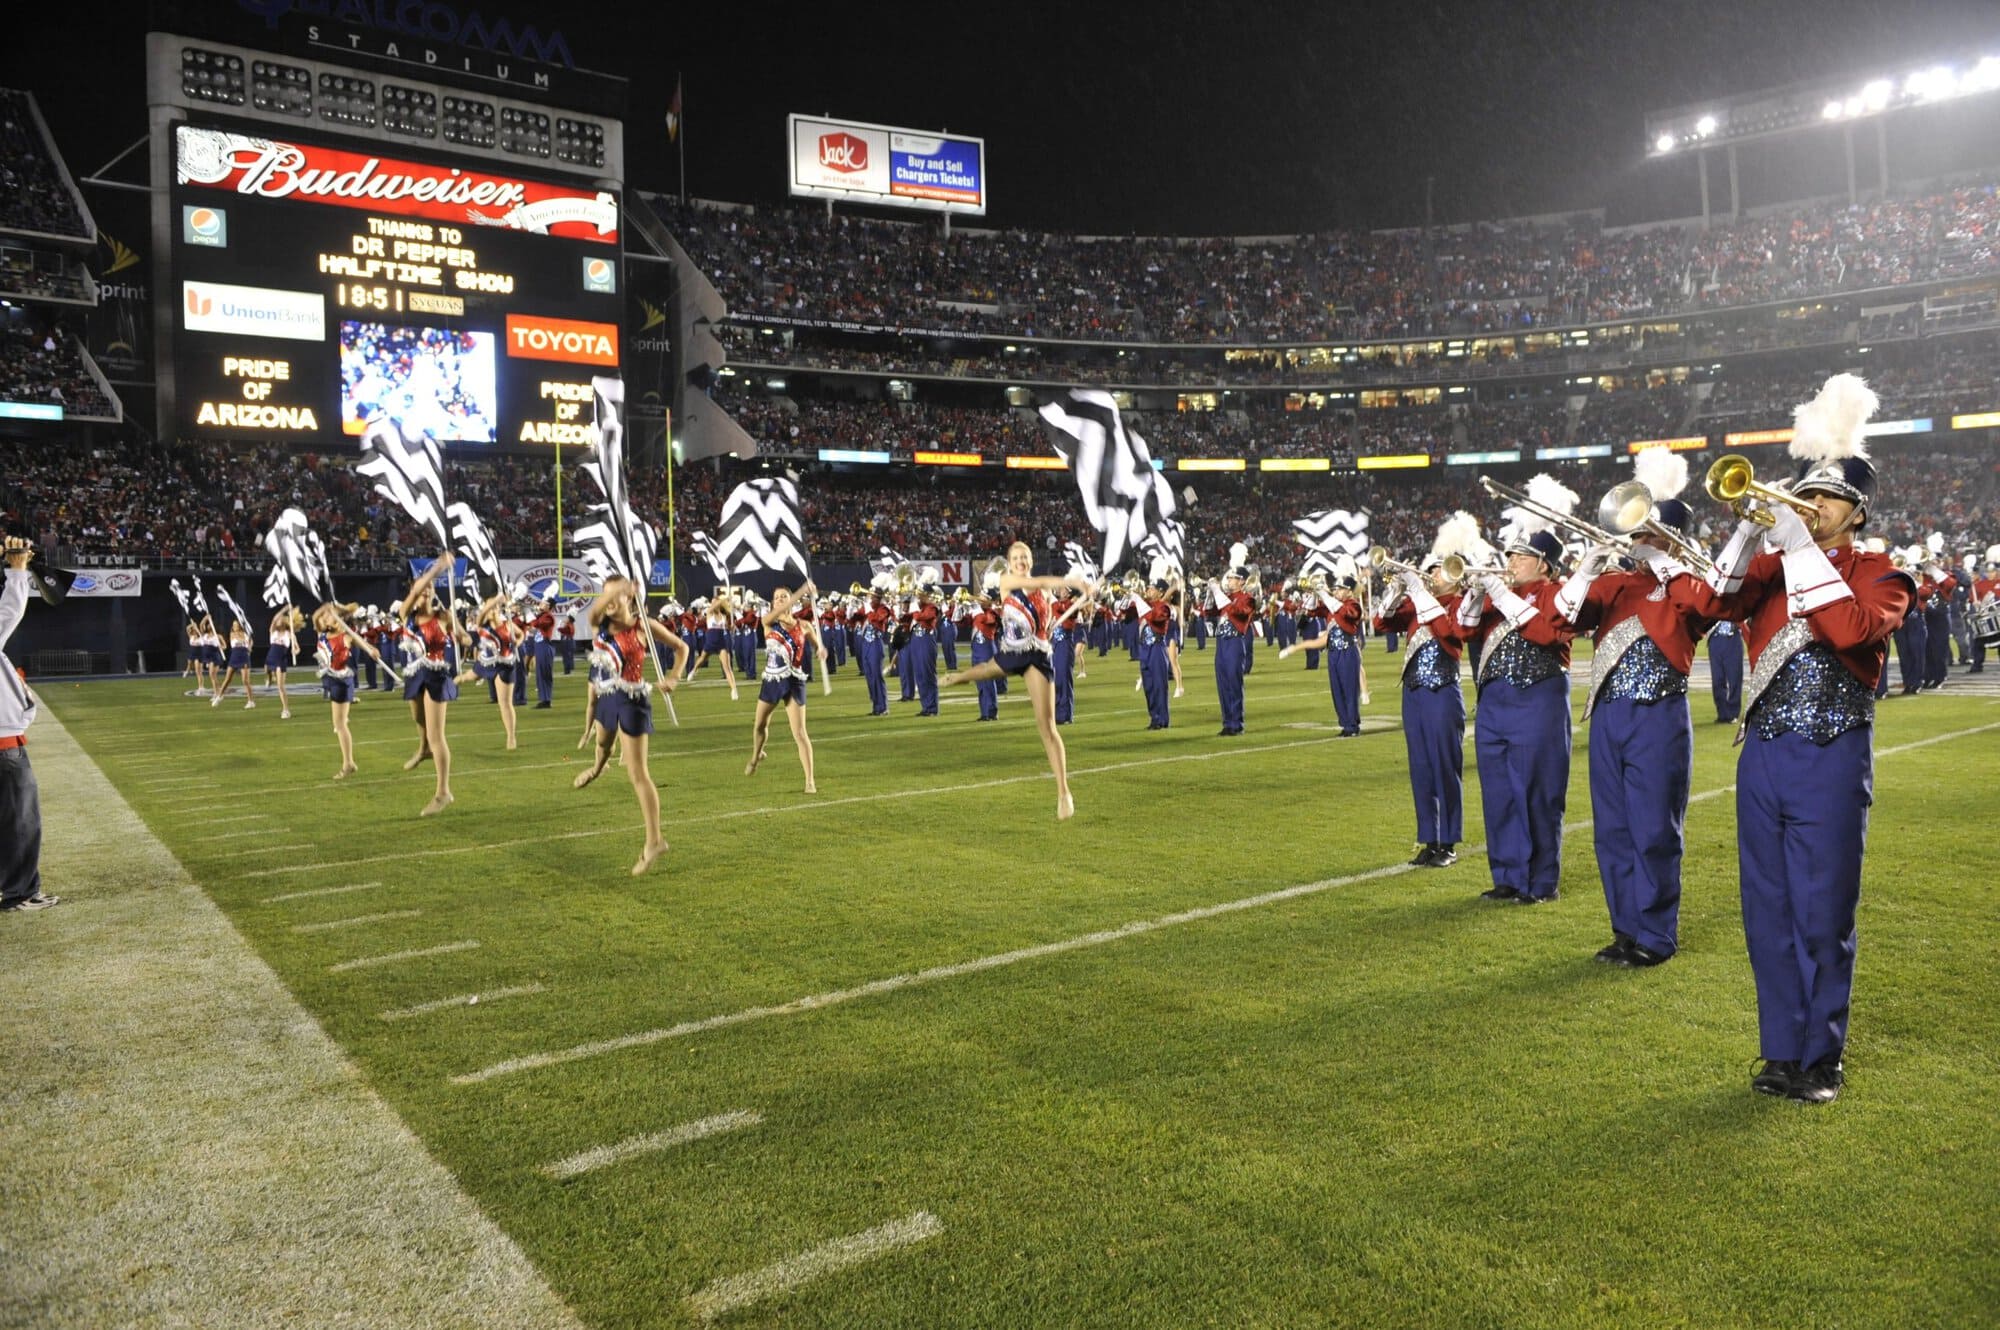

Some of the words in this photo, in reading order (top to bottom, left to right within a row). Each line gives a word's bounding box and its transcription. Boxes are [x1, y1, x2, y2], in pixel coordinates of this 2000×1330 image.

[308, 26, 549, 87] STADIUM
[821, 137, 866, 169] Jack
[908, 155, 925, 170] Buy
[927, 159, 944, 171] and
[946, 160, 963, 173] Sell
[225, 142, 524, 207] Budweiser
[896, 167, 938, 183] Chargers
[940, 172, 975, 187] Tickets!
[192, 235, 219, 245] pepsi
[368, 217, 433, 242] THANKS
[439, 227, 462, 245] TO
[352, 235, 385, 257] DR
[393, 240, 477, 269] PEPPER
[319, 253, 443, 287] HALFTIME
[455, 269, 514, 294] SHOW
[411, 297, 462, 311] SYCUAN
[814, 320, 828, 328] TEXT
[512, 327, 614, 356] TOYOTA
[630, 335, 671, 353] Sprint
[224, 357, 290, 380] PRIDE
[243, 381, 272, 401] OF
[541, 381, 594, 401] PRIDE
[197, 402, 318, 430] ARIZONA
[557, 403, 580, 420] OF
[523, 567, 560, 583] PACIFIC
[561, 567, 582, 583] LIFE
[941, 562, 963, 583] N
